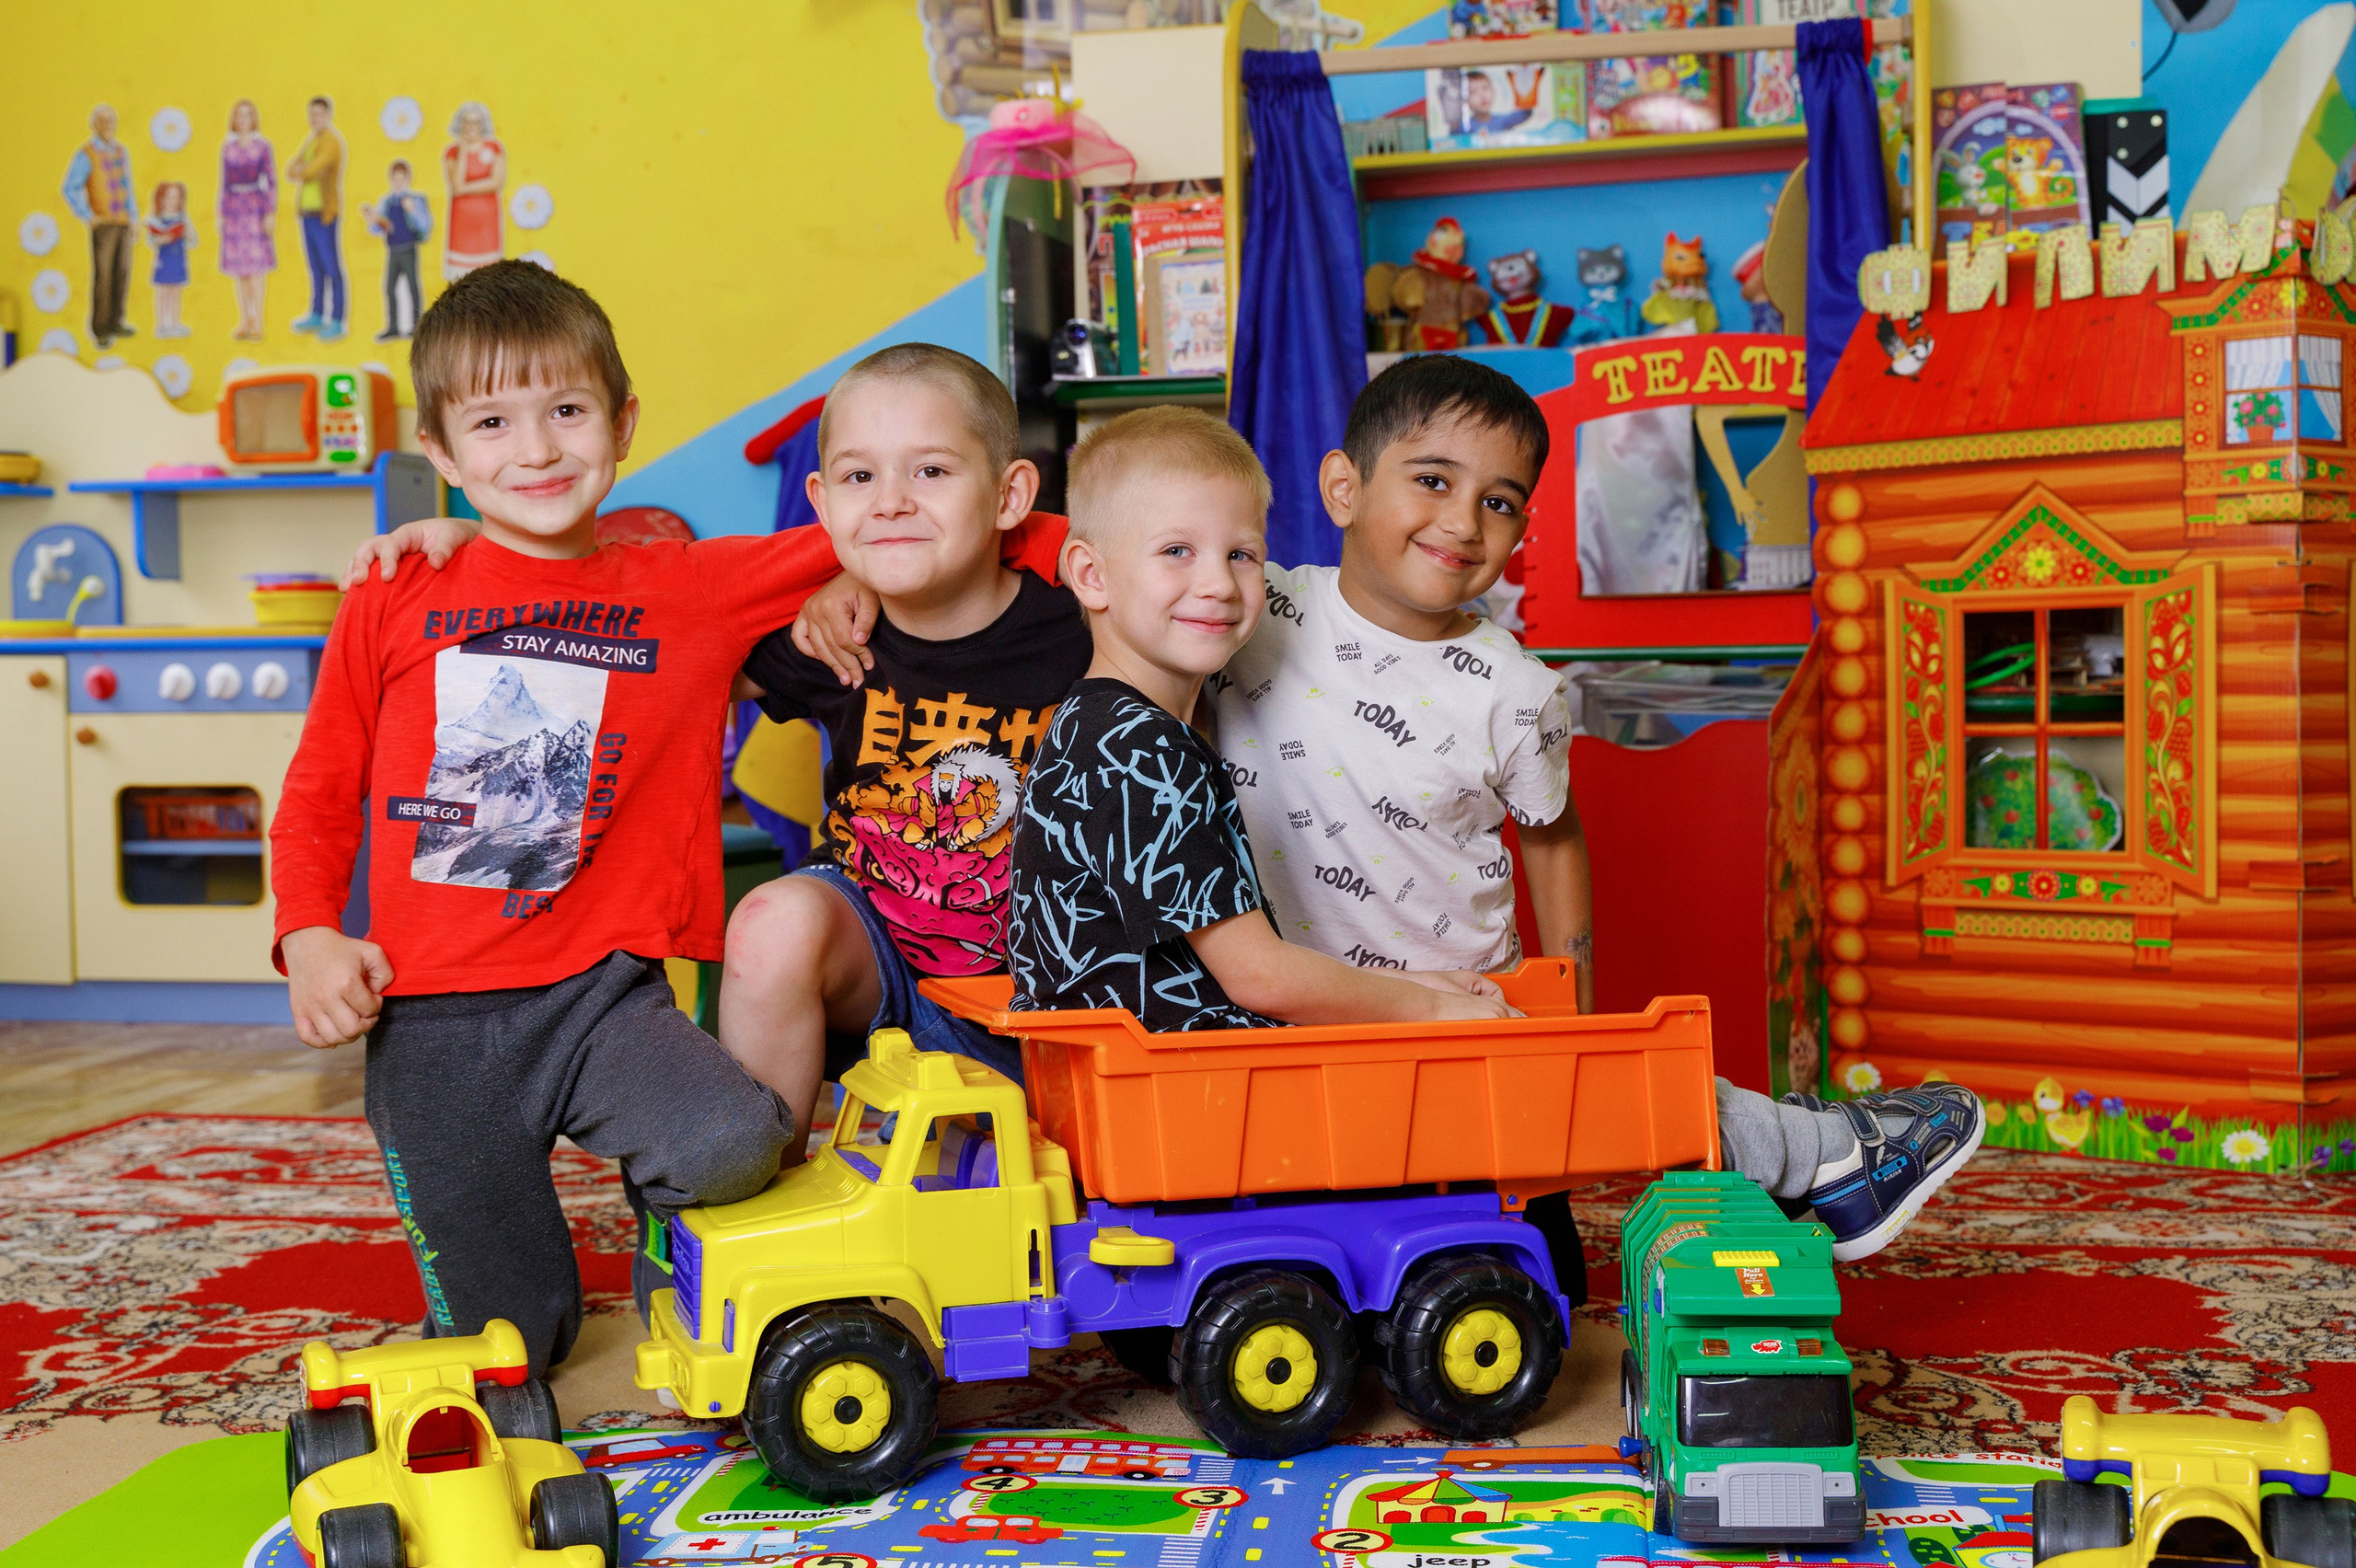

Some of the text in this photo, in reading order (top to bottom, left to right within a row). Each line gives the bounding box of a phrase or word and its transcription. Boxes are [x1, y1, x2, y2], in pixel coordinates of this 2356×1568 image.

[1265, 580, 1304, 627] TODA
[423, 600, 645, 640] EVERYWHERE
[502, 635, 647, 665] STAY AMAZING
[1335, 642, 1360, 653] SMILE
[1336, 651, 1362, 663] TODAY
[1441, 645, 1493, 680] TODA
[1516, 709, 1539, 717] SMILE
[1354, 699, 1416, 748] TODAY
[598, 732, 627, 764] GO
[1279, 740, 1304, 752] TODAY
[1281, 749, 1306, 761] SMILE
[587, 774, 618, 821] FOR
[398, 802, 461, 820] HERE WE GO
[1288, 809, 1311, 820] SMILE
[1371, 796, 1427, 832] TODAY
[1504, 798, 1545, 826] TODA
[1290, 818, 1313, 829] TODAY
[1315, 865, 1376, 902] TODAY
[1975, 1452, 2062, 1469] statio
[976, 1477, 1014, 1490] 4
[1189, 1489, 1228, 1505] 3
[704, 1507, 872, 1522] ambulance
[1865, 1509, 1965, 1528] chool
[1333, 1531, 1370, 1551] 2
[1407, 1554, 1491, 1568] jeep
